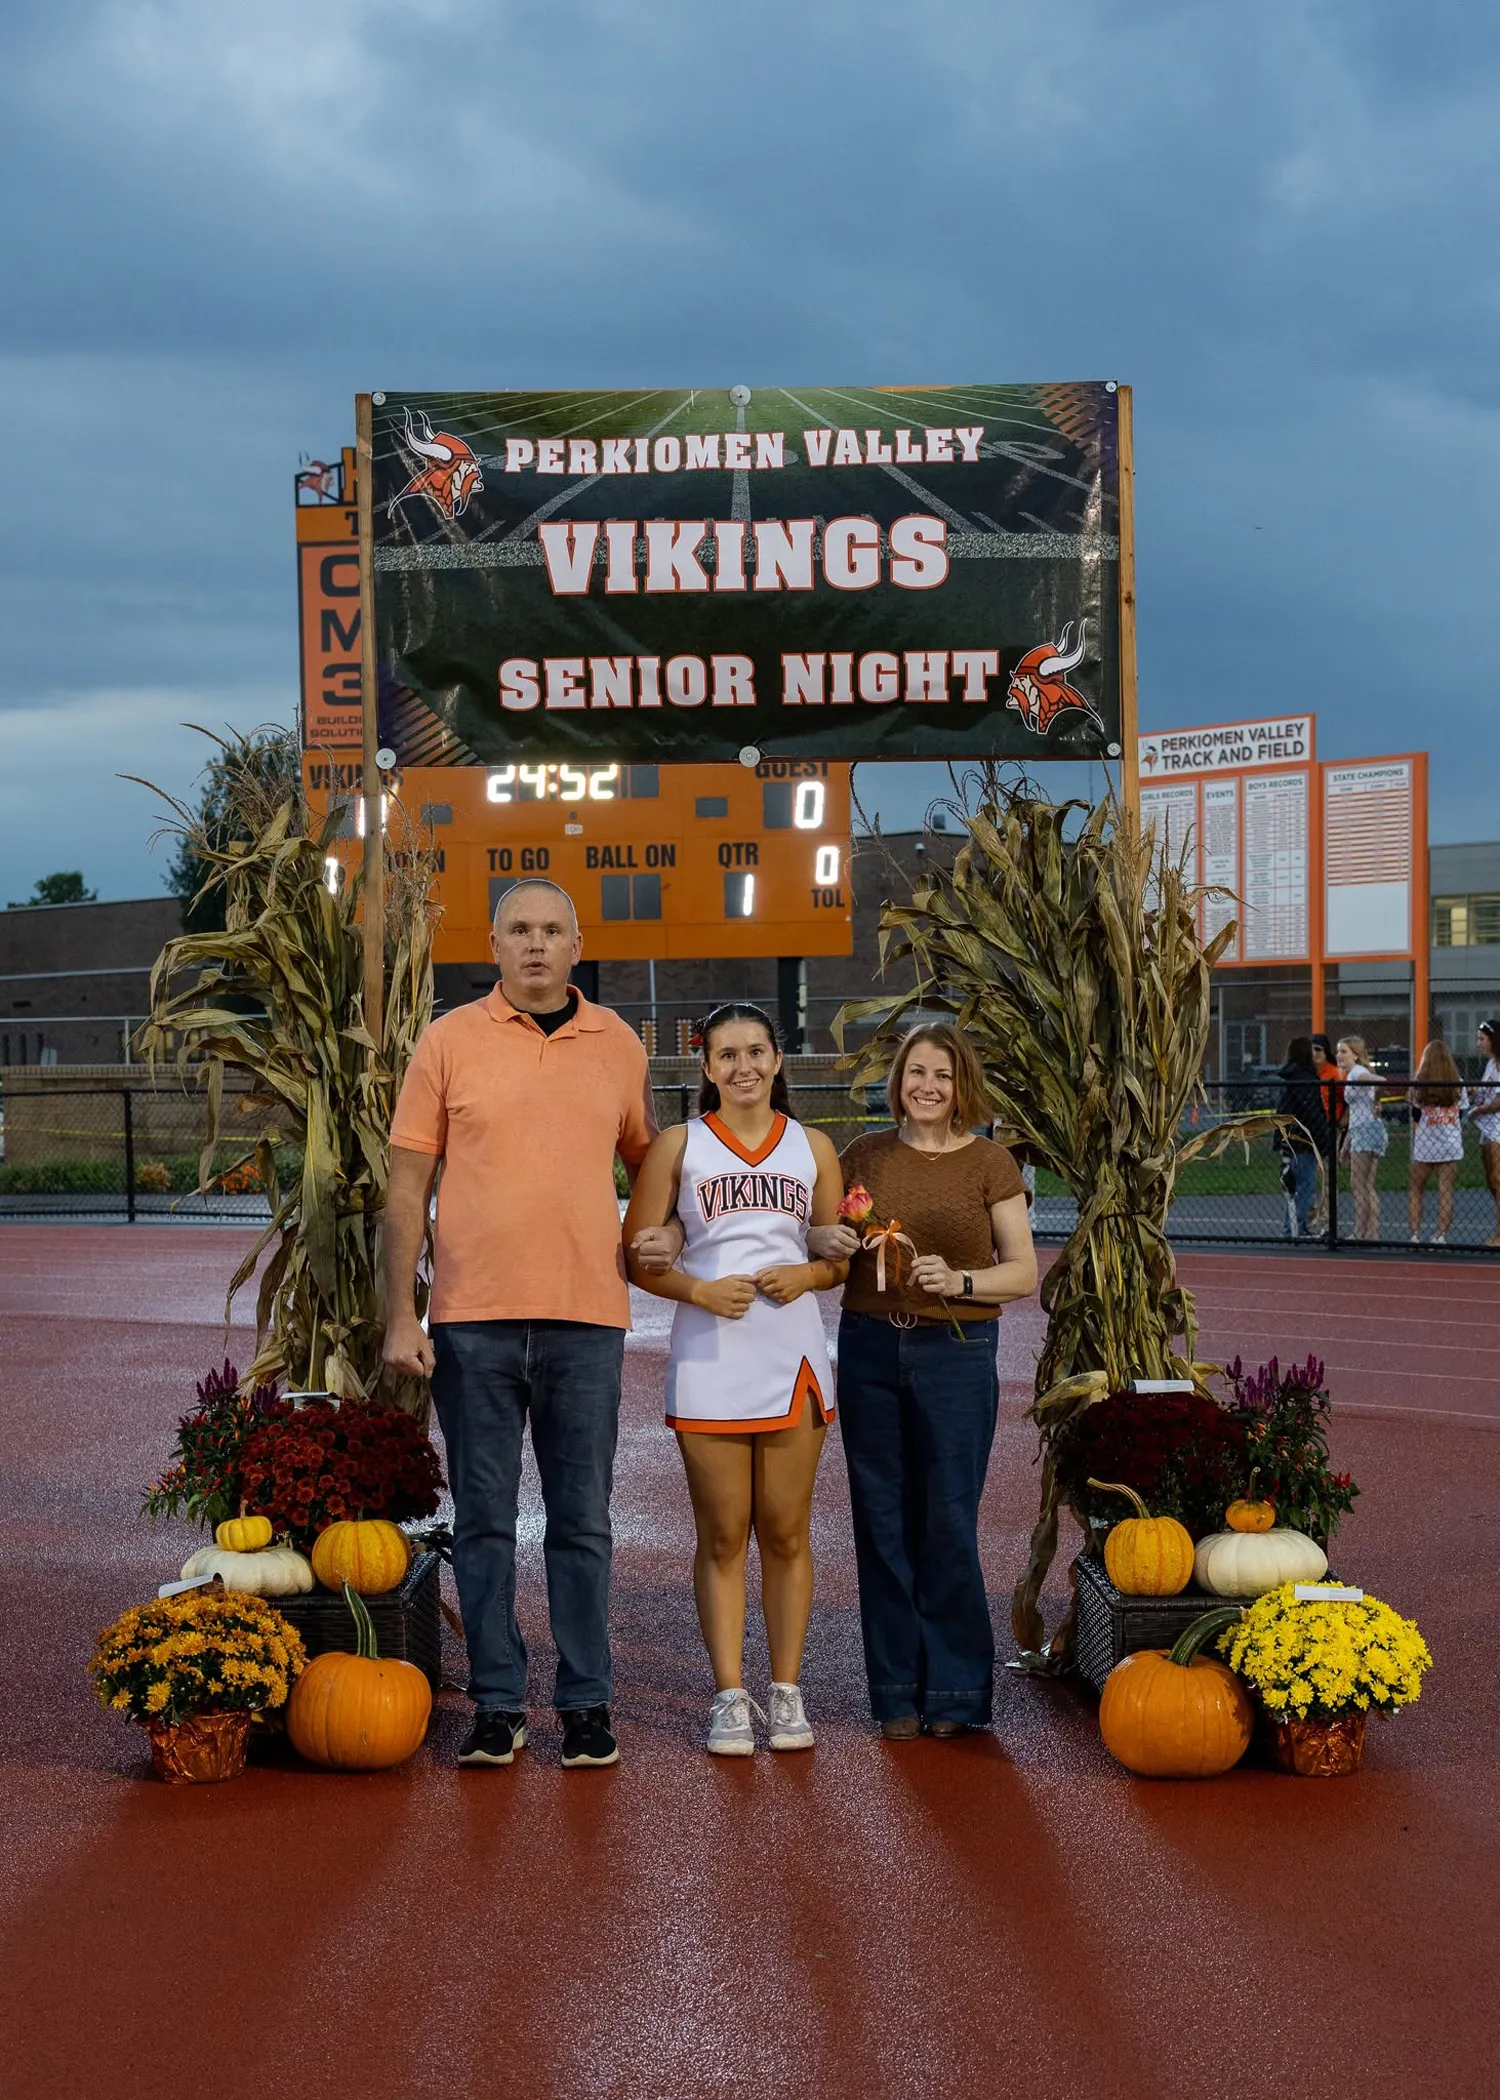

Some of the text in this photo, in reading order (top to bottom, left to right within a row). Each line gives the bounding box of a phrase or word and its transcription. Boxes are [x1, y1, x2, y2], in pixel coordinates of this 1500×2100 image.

[504, 426, 985, 475] PERKIOMEN VALLEY
[539, 515, 950, 596] VIKINGS
[498, 649, 1000, 711] SENIOR NIGHT
[310, 728, 362, 738] SOLUTI
[1162, 723, 1305, 751] PERKIOMEN VALLEY
[1162, 741, 1304, 770] TRACK AND FIELD
[487, 763, 618, 803] 24:52
[755, 762, 829, 778] GUEST
[1269, 778, 1303, 788] RECORDS
[1333, 768, 1404, 782] STATE CHAMPIONS
[794, 781, 825, 829] 0
[1206, 790, 1234, 799] EVENTS
[487, 847, 550, 871] TO GO
[586, 844, 676, 869] BALL ON
[718, 842, 759, 868] QTR
[815, 846, 839, 885] 0
[743, 873, 754, 916] 1
[811, 889, 846, 908] TOL
[697, 1172, 809, 1224] VIKINGS
